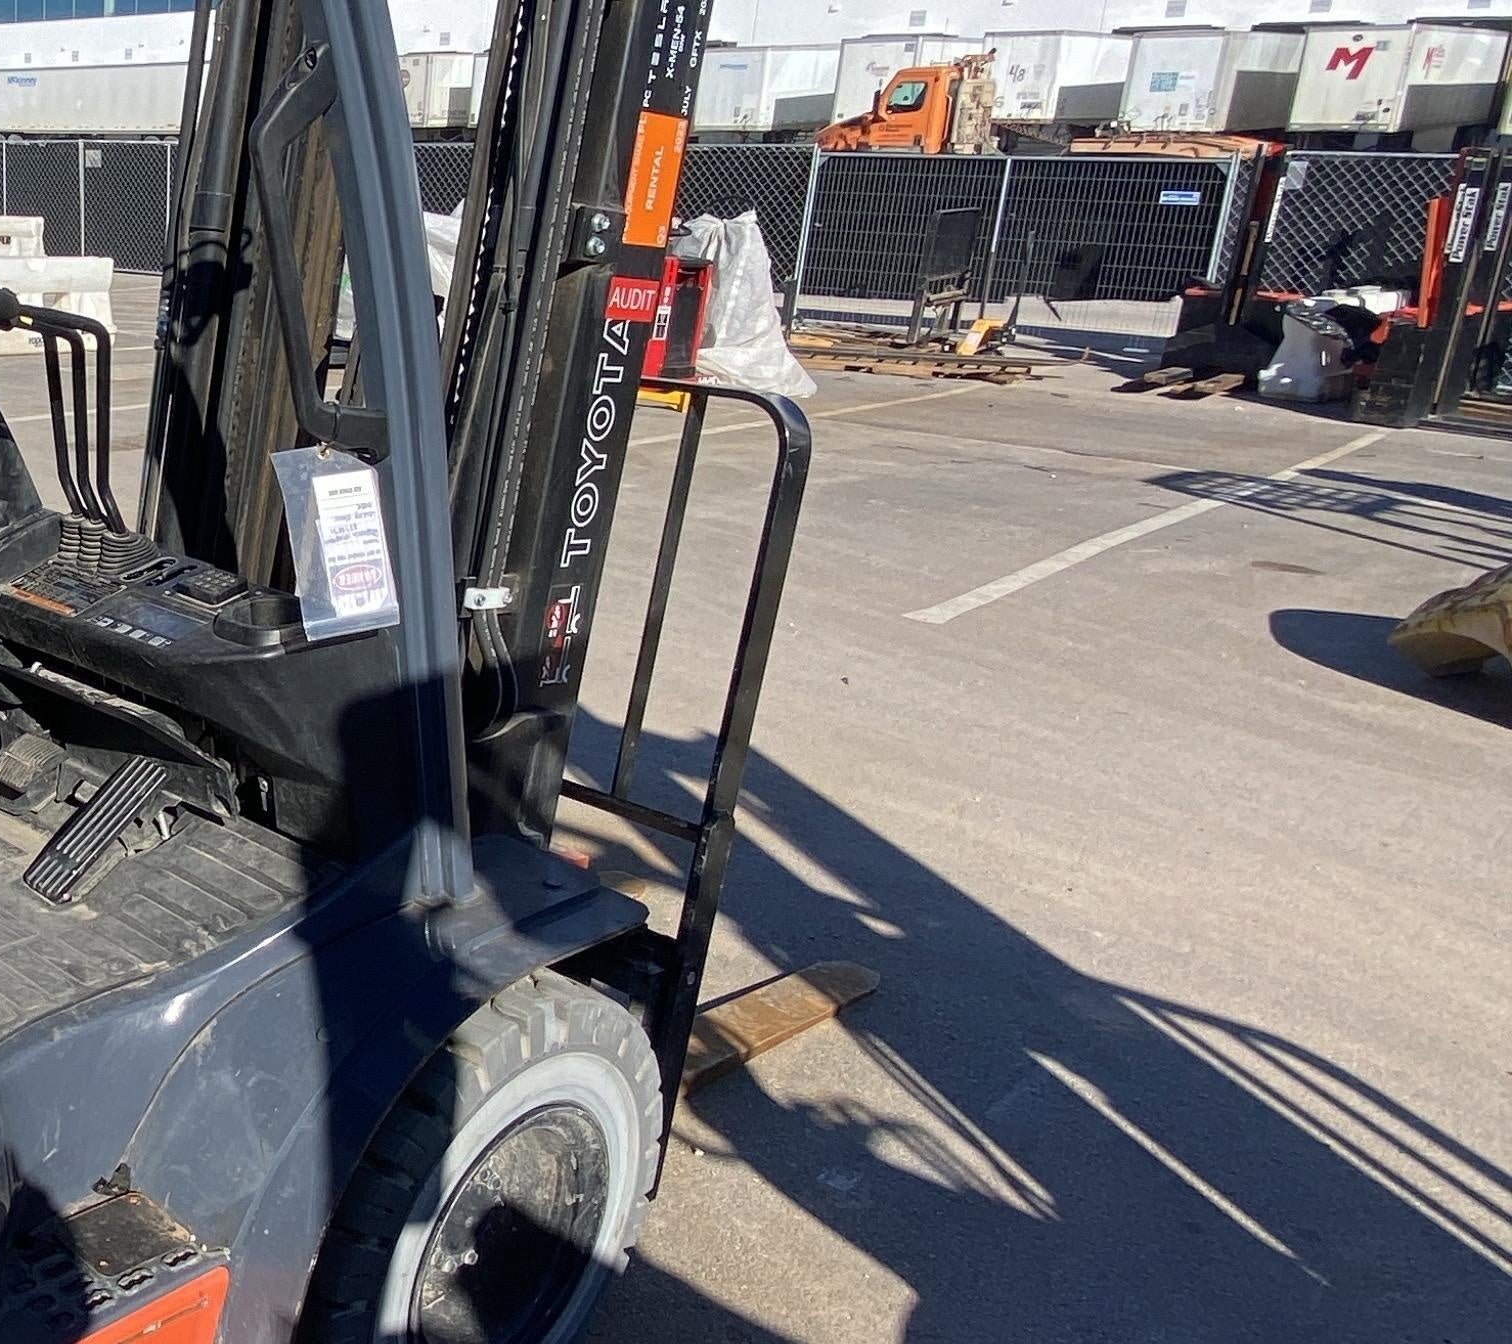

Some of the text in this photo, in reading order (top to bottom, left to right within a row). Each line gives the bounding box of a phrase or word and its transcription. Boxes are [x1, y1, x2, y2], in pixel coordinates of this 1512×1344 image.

[665, 5, 686, 78] X-MEN-54
[680, 86, 693, 116] JULY
[674, 121, 686, 153] 2023
[645, 146, 664, 210] RENTAL
[608, 286, 658, 312] AUDIT
[561, 318, 632, 569] TOYOTA
